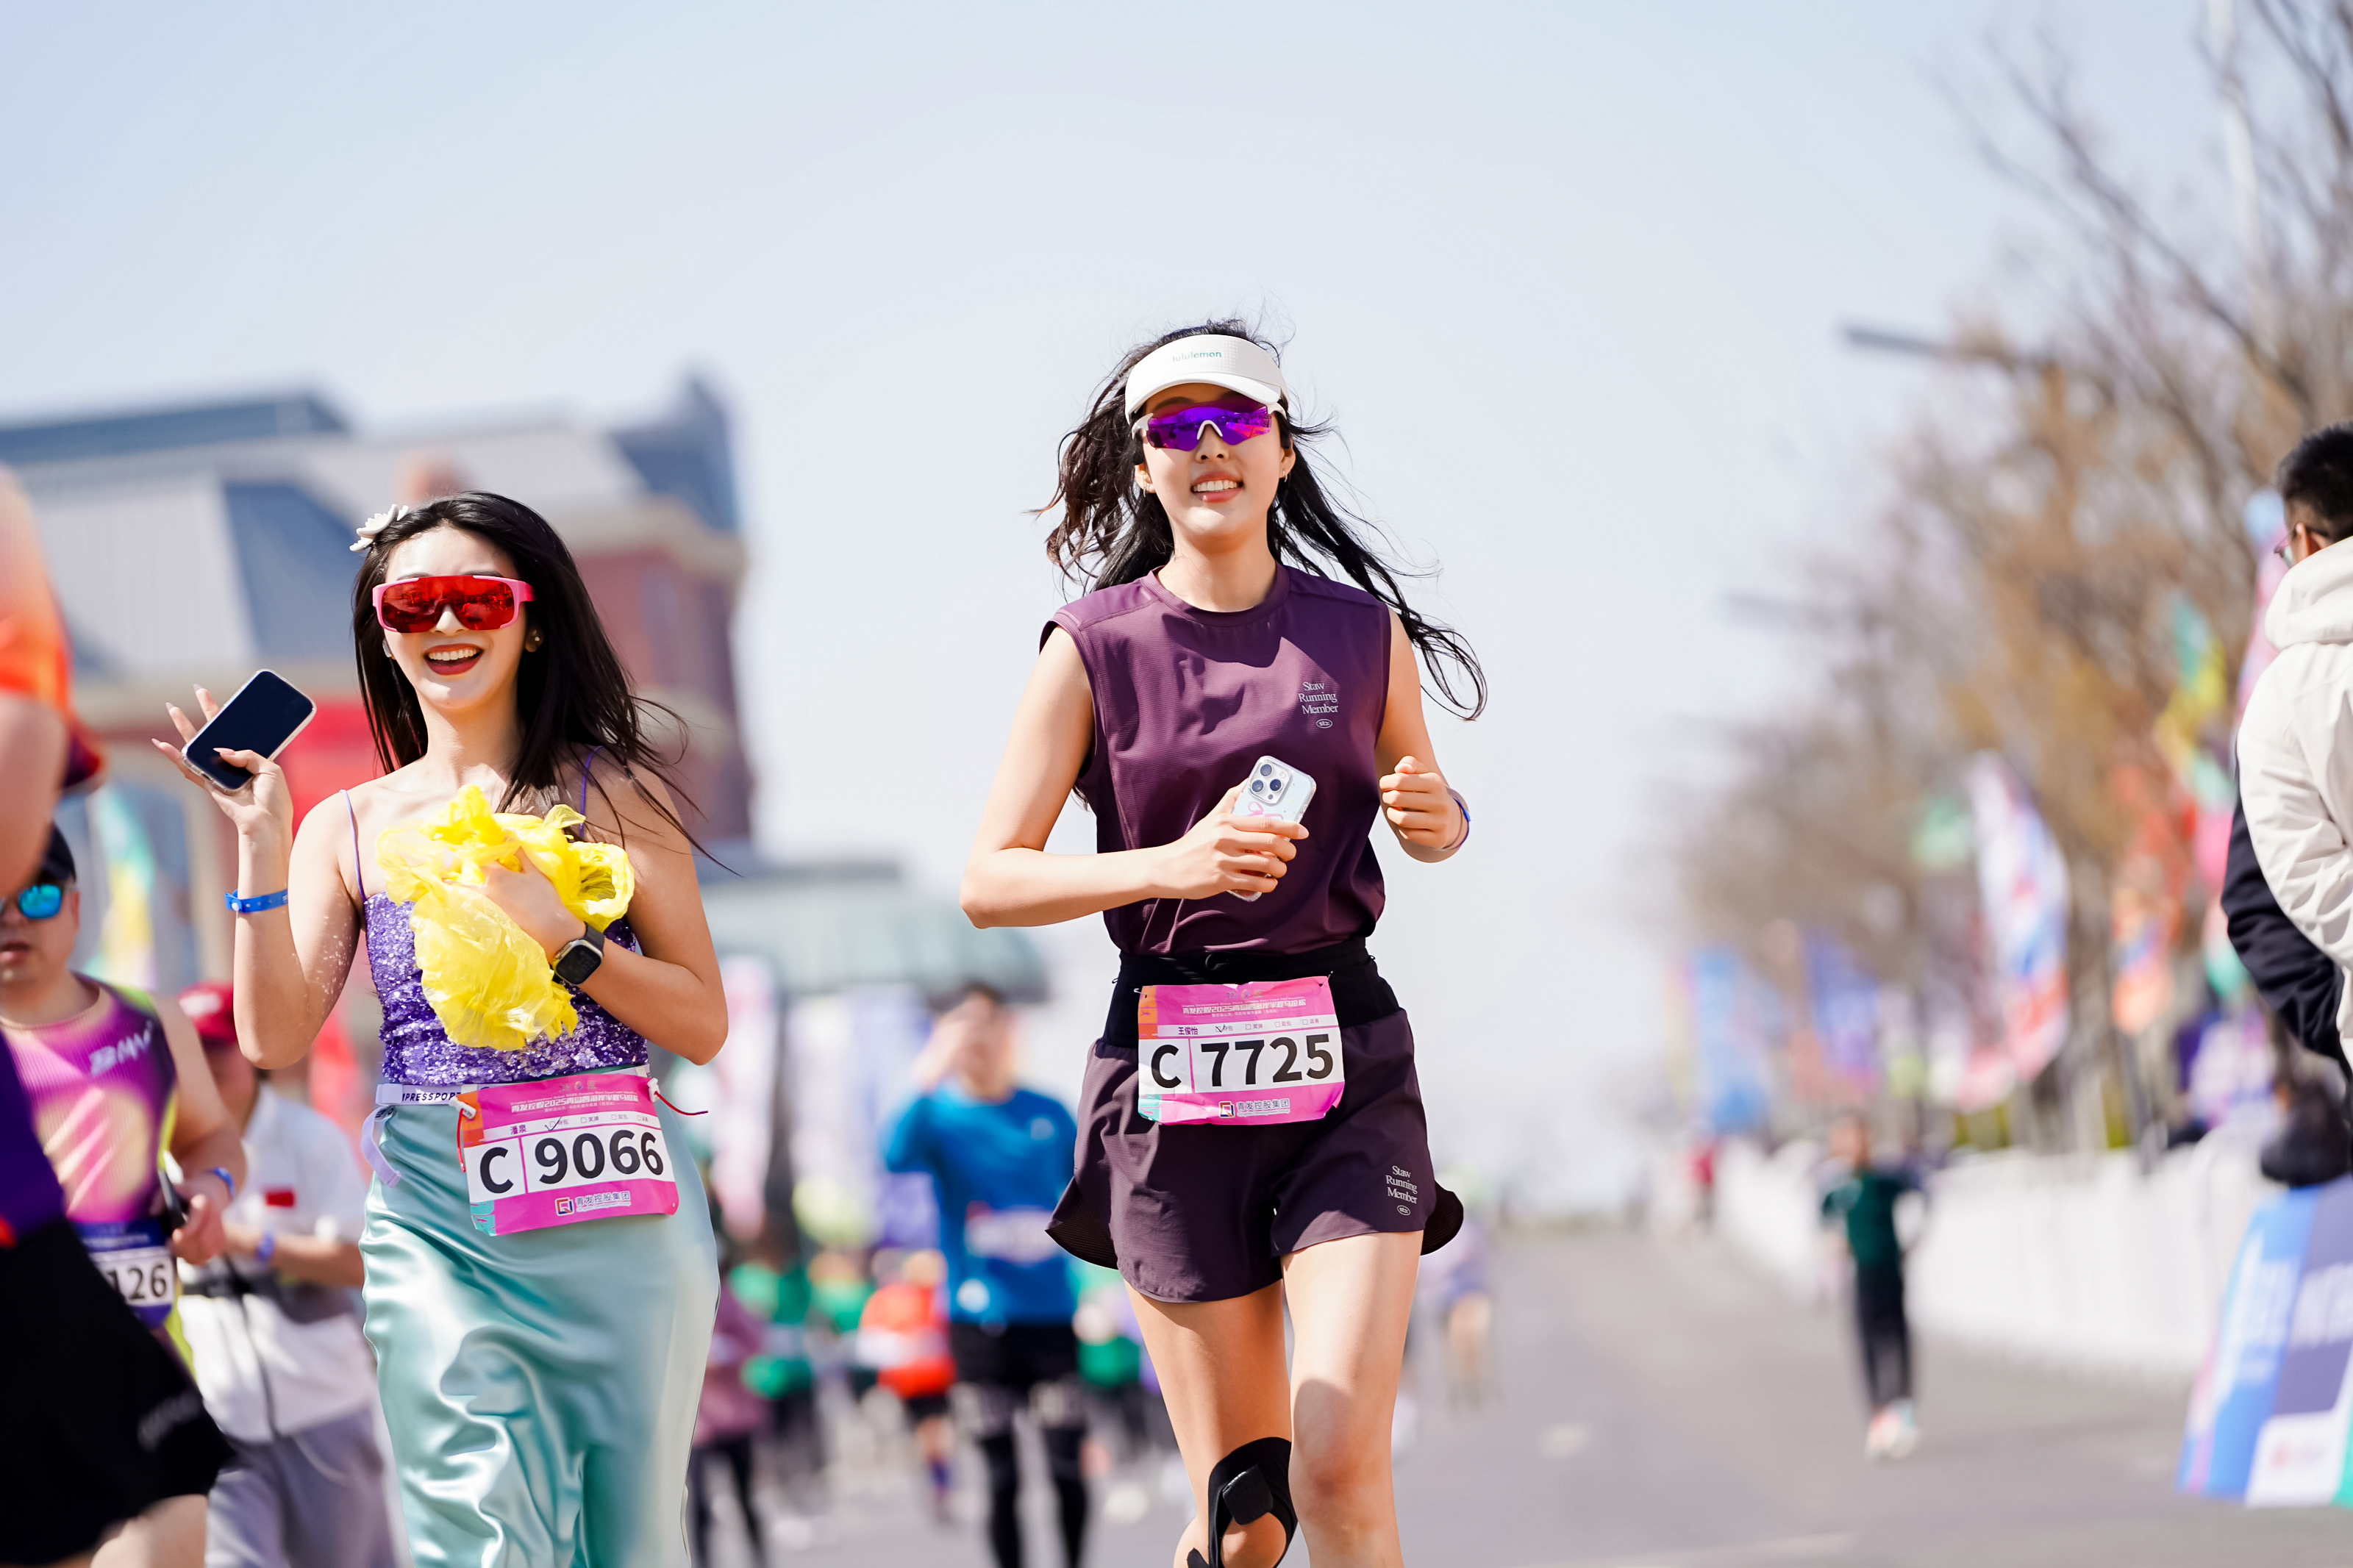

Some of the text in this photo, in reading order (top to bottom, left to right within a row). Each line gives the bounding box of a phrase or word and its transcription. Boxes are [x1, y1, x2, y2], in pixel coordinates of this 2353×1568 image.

[1173, 351, 1221, 362] lululemon
[1303, 682, 1324, 691] Staw
[1299, 692, 1338, 703] Running
[1302, 704, 1338, 715] Member
[1151, 1034, 1333, 1089] C 7725
[480, 1130, 663, 1194] C 9066
[1392, 1165, 1411, 1178] Staw
[1385, 1175, 1418, 1195] Running
[1388, 1187, 1417, 1203] Member
